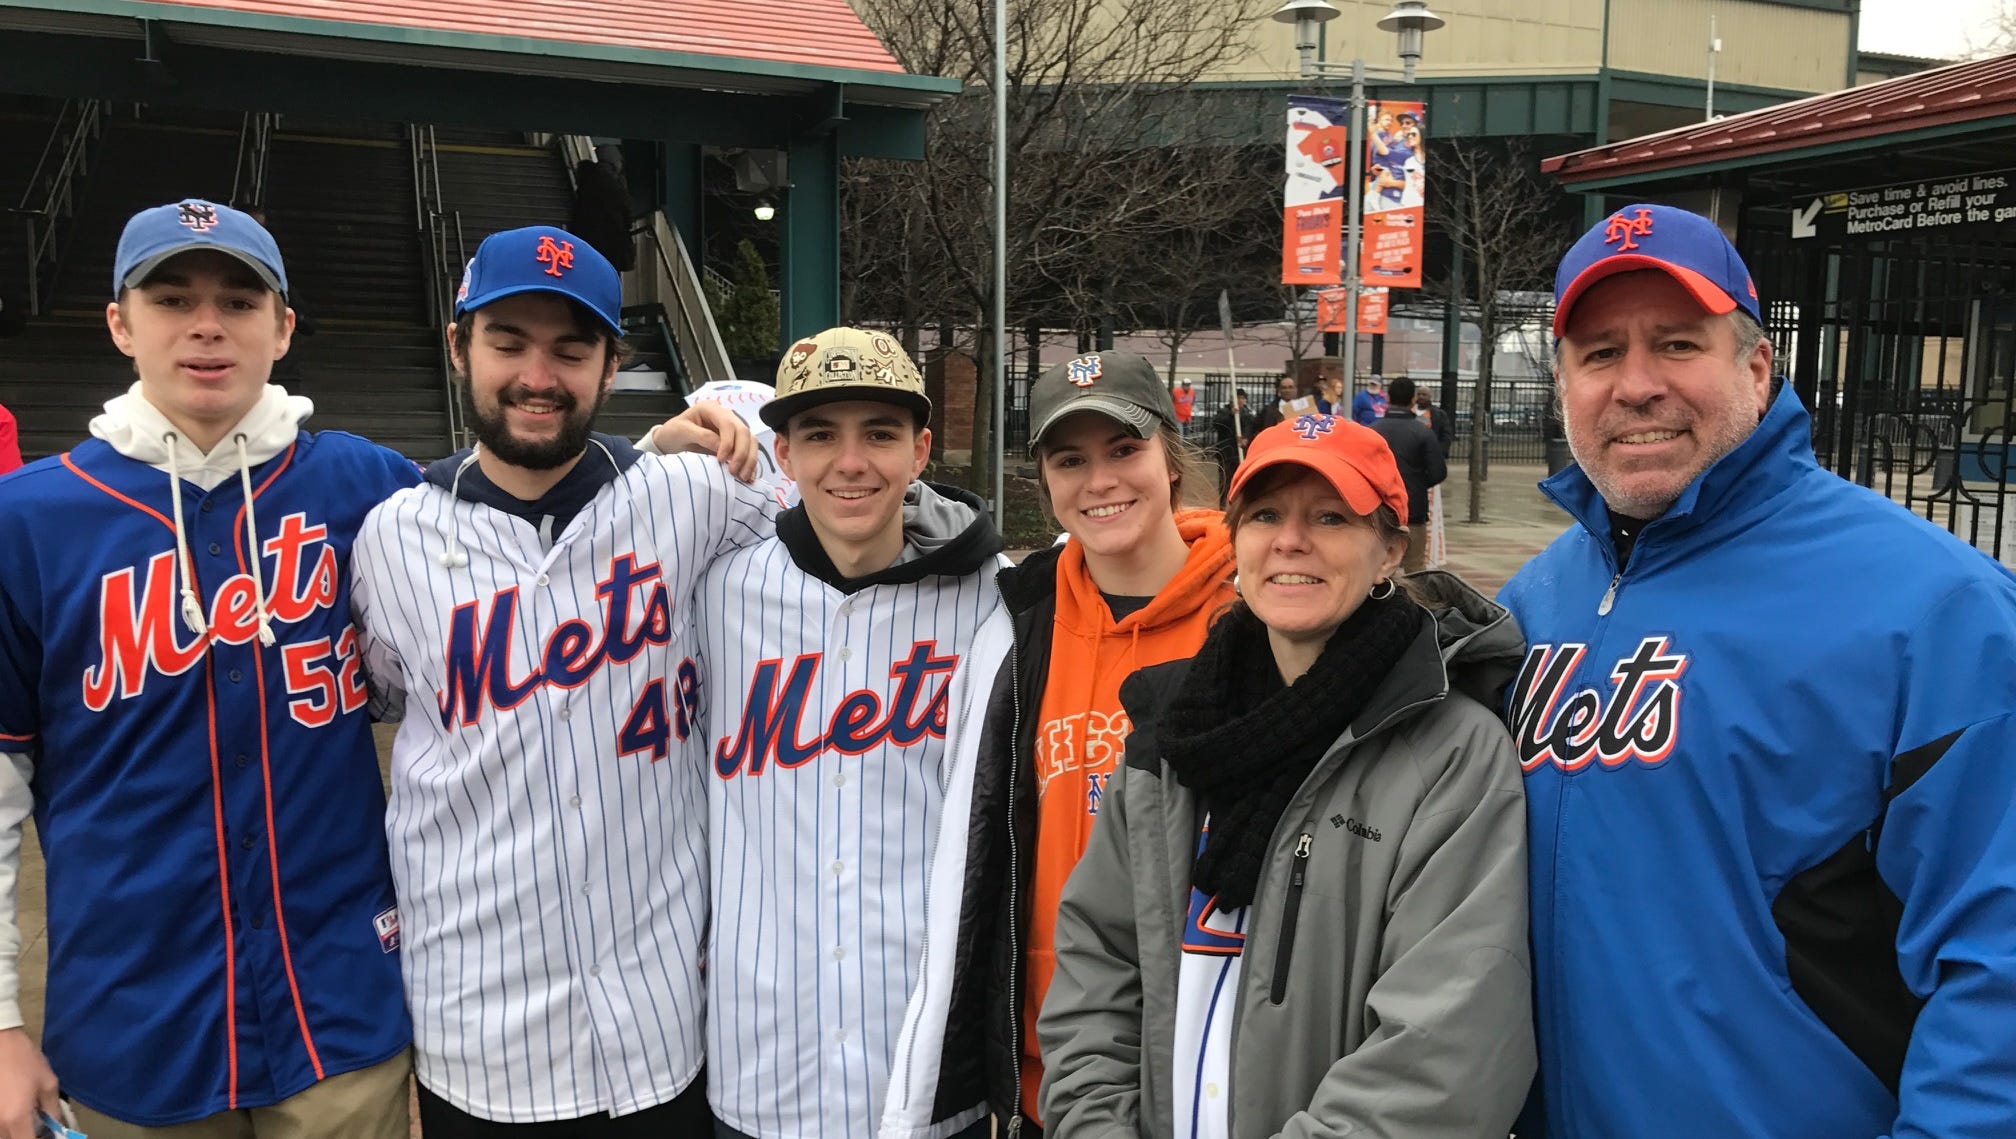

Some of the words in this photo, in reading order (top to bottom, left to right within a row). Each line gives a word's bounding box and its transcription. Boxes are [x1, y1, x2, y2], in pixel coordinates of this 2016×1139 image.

[1847, 215, 1913, 234] MetroCard
[1916, 211, 1962, 228] Before
[1967, 207, 1990, 222] the
[1848, 202, 1905, 220] Purchase
[1909, 199, 1924, 213] or
[1928, 194, 1961, 211] Refill
[1965, 193, 1997, 209] your
[1849, 191, 1880, 206] Save
[1884, 188, 1911, 202] time
[1916, 184, 1927, 197] &
[1932, 178, 1969, 196] avoid
[1972, 176, 2008, 191] lines.
[82, 512, 339, 712] Mets
[437, 552, 673, 733] Mets
[281, 623, 368, 728] 52
[617, 657, 698, 763] 48
[715, 640, 960, 780] Mets
[1507, 636, 1688, 772] Mets
[1346, 818, 1382, 842] Columbia
